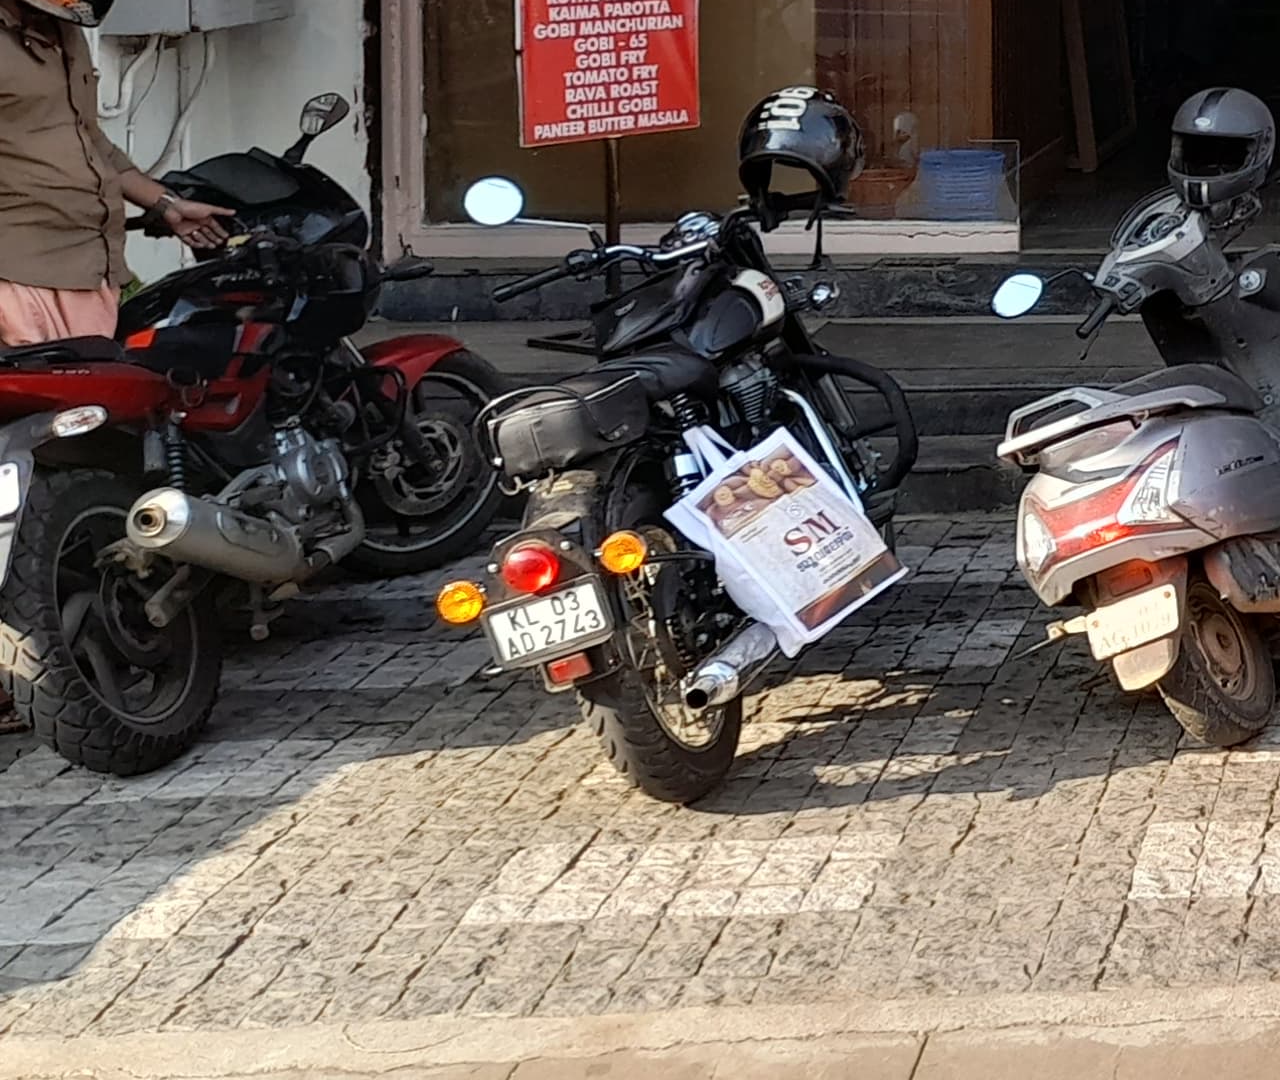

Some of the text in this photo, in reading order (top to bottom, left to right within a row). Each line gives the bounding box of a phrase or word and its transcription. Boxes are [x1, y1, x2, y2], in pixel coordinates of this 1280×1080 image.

[548, 0, 671, 21] KAIMA PAROTTA
[533, 15, 683, 39] GOBI MANCHURIAN
[573, 36, 615, 52] GOBI
[629, 33, 647, 49] 65
[576, 49, 647, 69] GOBI FRY
[563, 64, 659, 86] TOMATO FRY
[564, 80, 659, 103] RAVA ROAST
[566, 96, 658, 119] CHILLI GOBI
[534, 109, 689, 140] PANEER BUTTER MASALA
[783, 509, 842, 556] SM
[507, 591, 581, 632] KL 03
[539, 609, 601, 646] 2743
